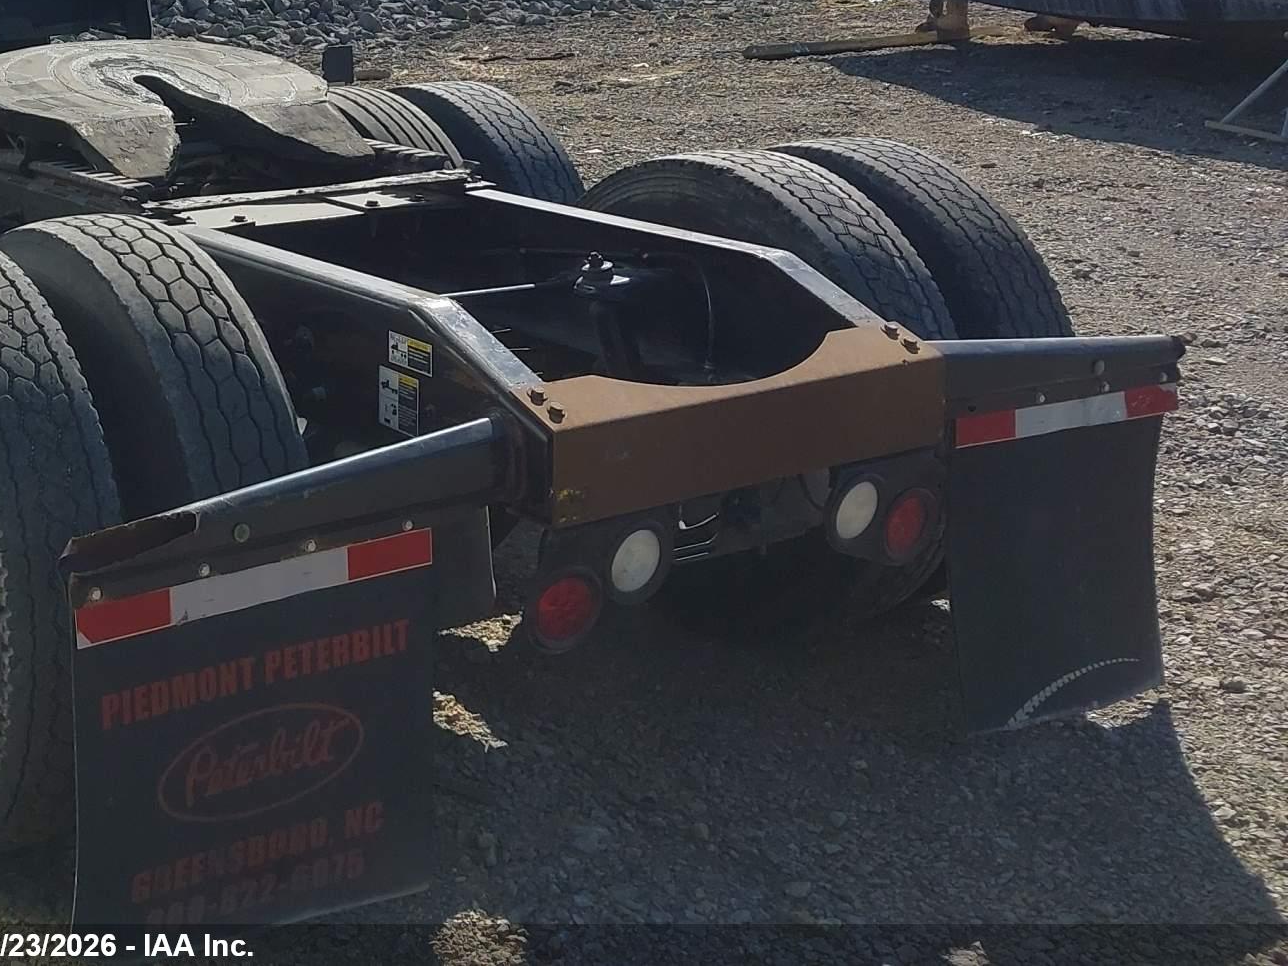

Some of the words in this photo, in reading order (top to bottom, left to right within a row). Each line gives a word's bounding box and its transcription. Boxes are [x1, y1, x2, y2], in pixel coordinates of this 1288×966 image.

[100, 657, 257, 730] PIEDMONT
[264, 618, 411, 684] PETERBILT
[184, 717, 350, 808] Peterbilt
[344, 800, 385, 840] NC
